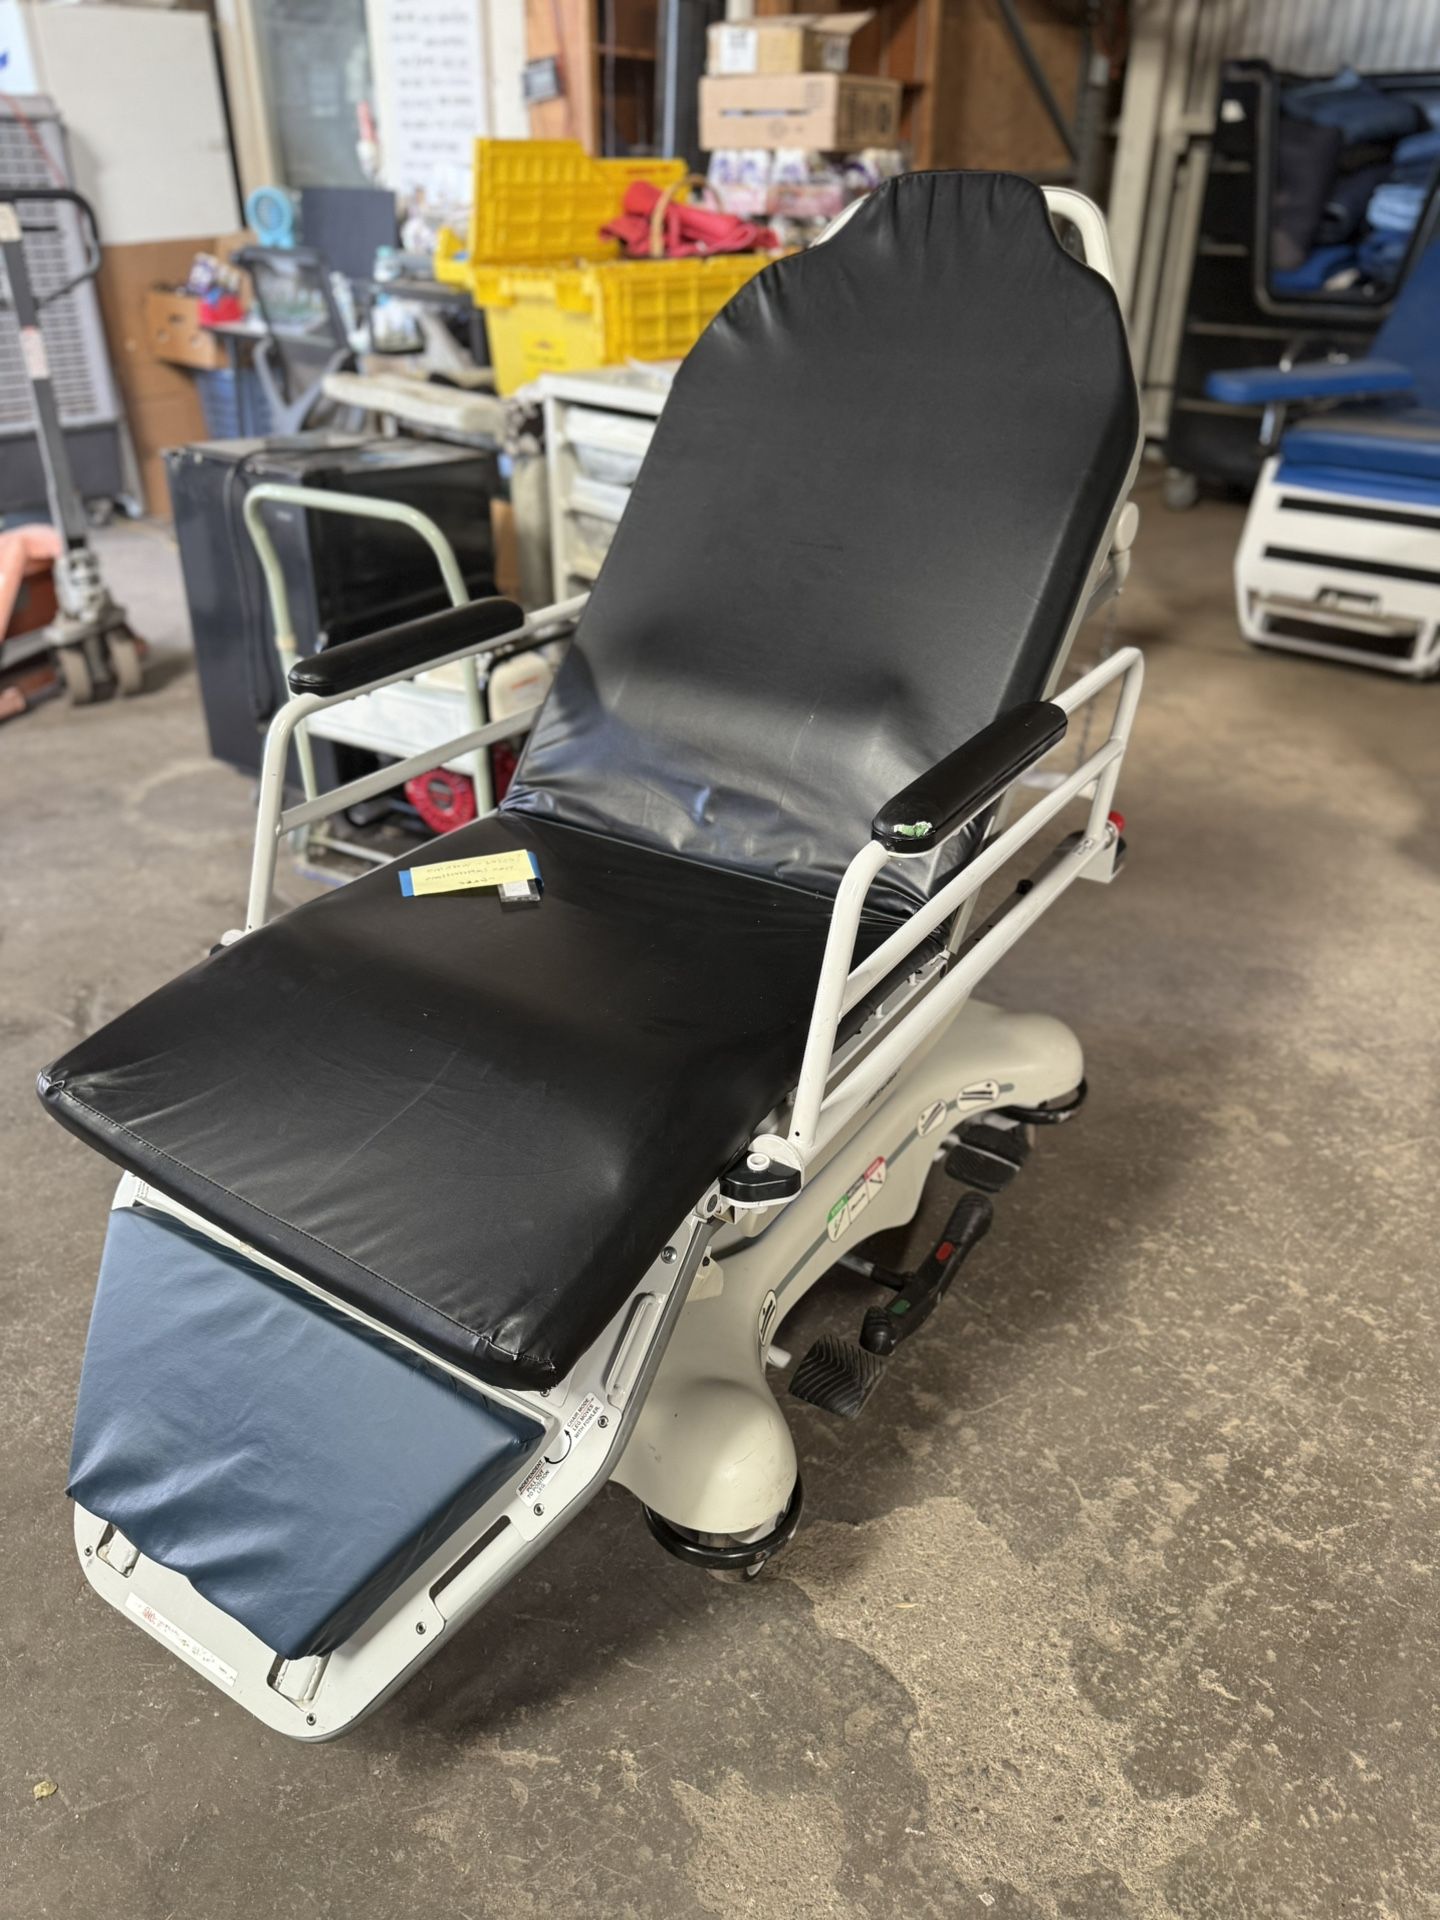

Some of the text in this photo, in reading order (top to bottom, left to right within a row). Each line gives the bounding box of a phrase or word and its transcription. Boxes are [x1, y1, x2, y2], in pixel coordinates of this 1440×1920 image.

[566, 1397, 590, 1427] CHAIR MODE
[572, 1403, 595, 1431] LEG MOVES
[574, 1424, 585, 1439] WITH
[518, 1459, 543, 1492] INDEPENDENT
[526, 1469, 545, 1492] PULL OUT
[527, 1490, 534, 1499] TO
